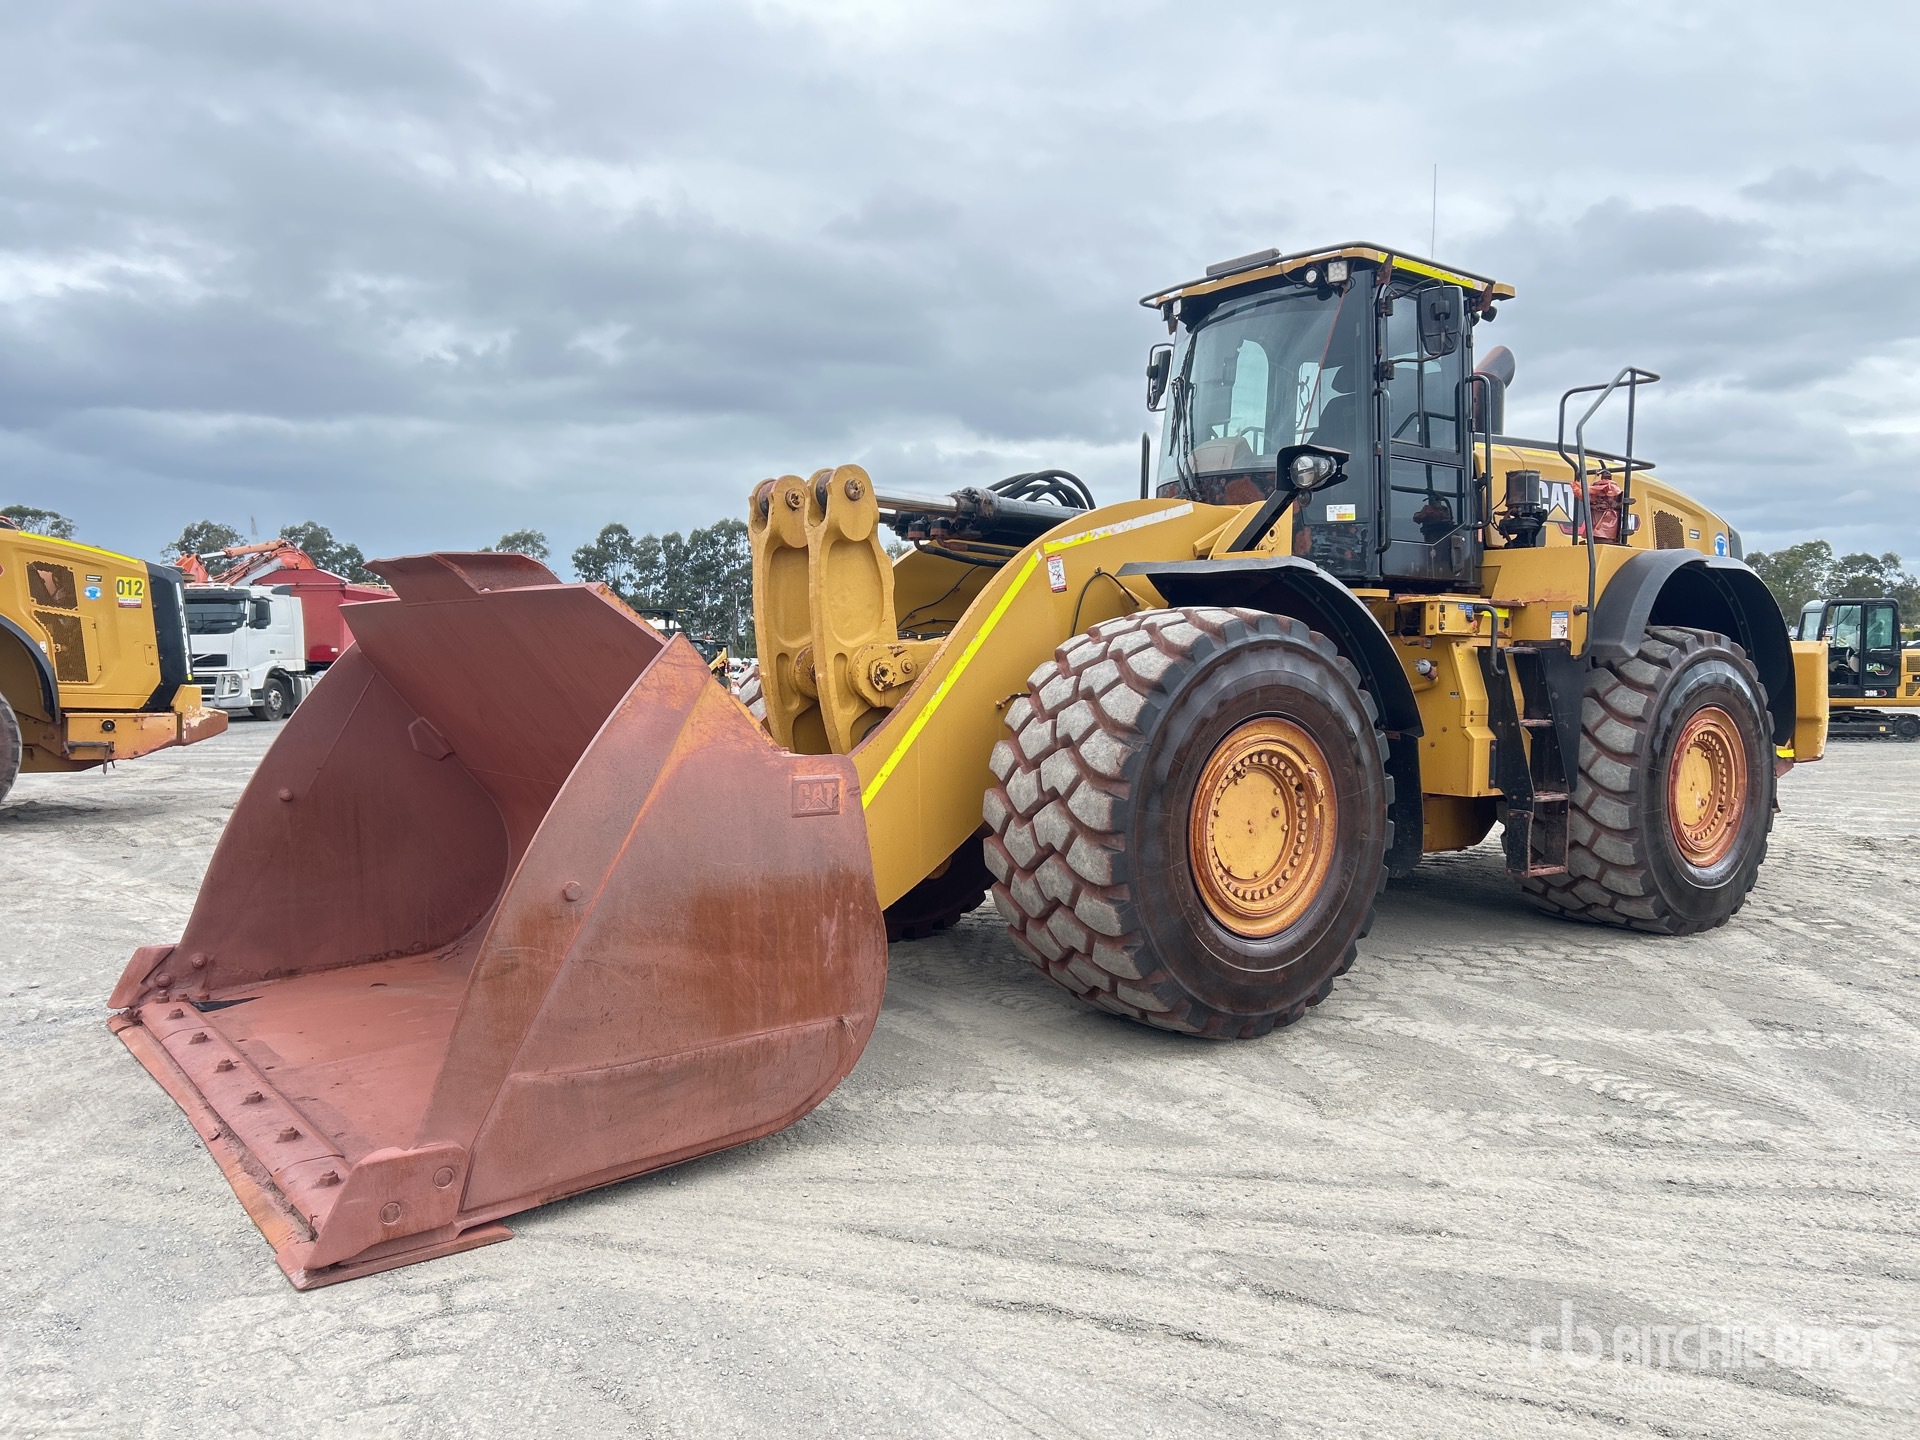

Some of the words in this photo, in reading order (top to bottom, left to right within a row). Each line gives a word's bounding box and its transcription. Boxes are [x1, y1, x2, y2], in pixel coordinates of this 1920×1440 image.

[1539, 481, 1575, 522] CAT
[116, 579, 143, 596] 012
[798, 782, 836, 810] CAT
